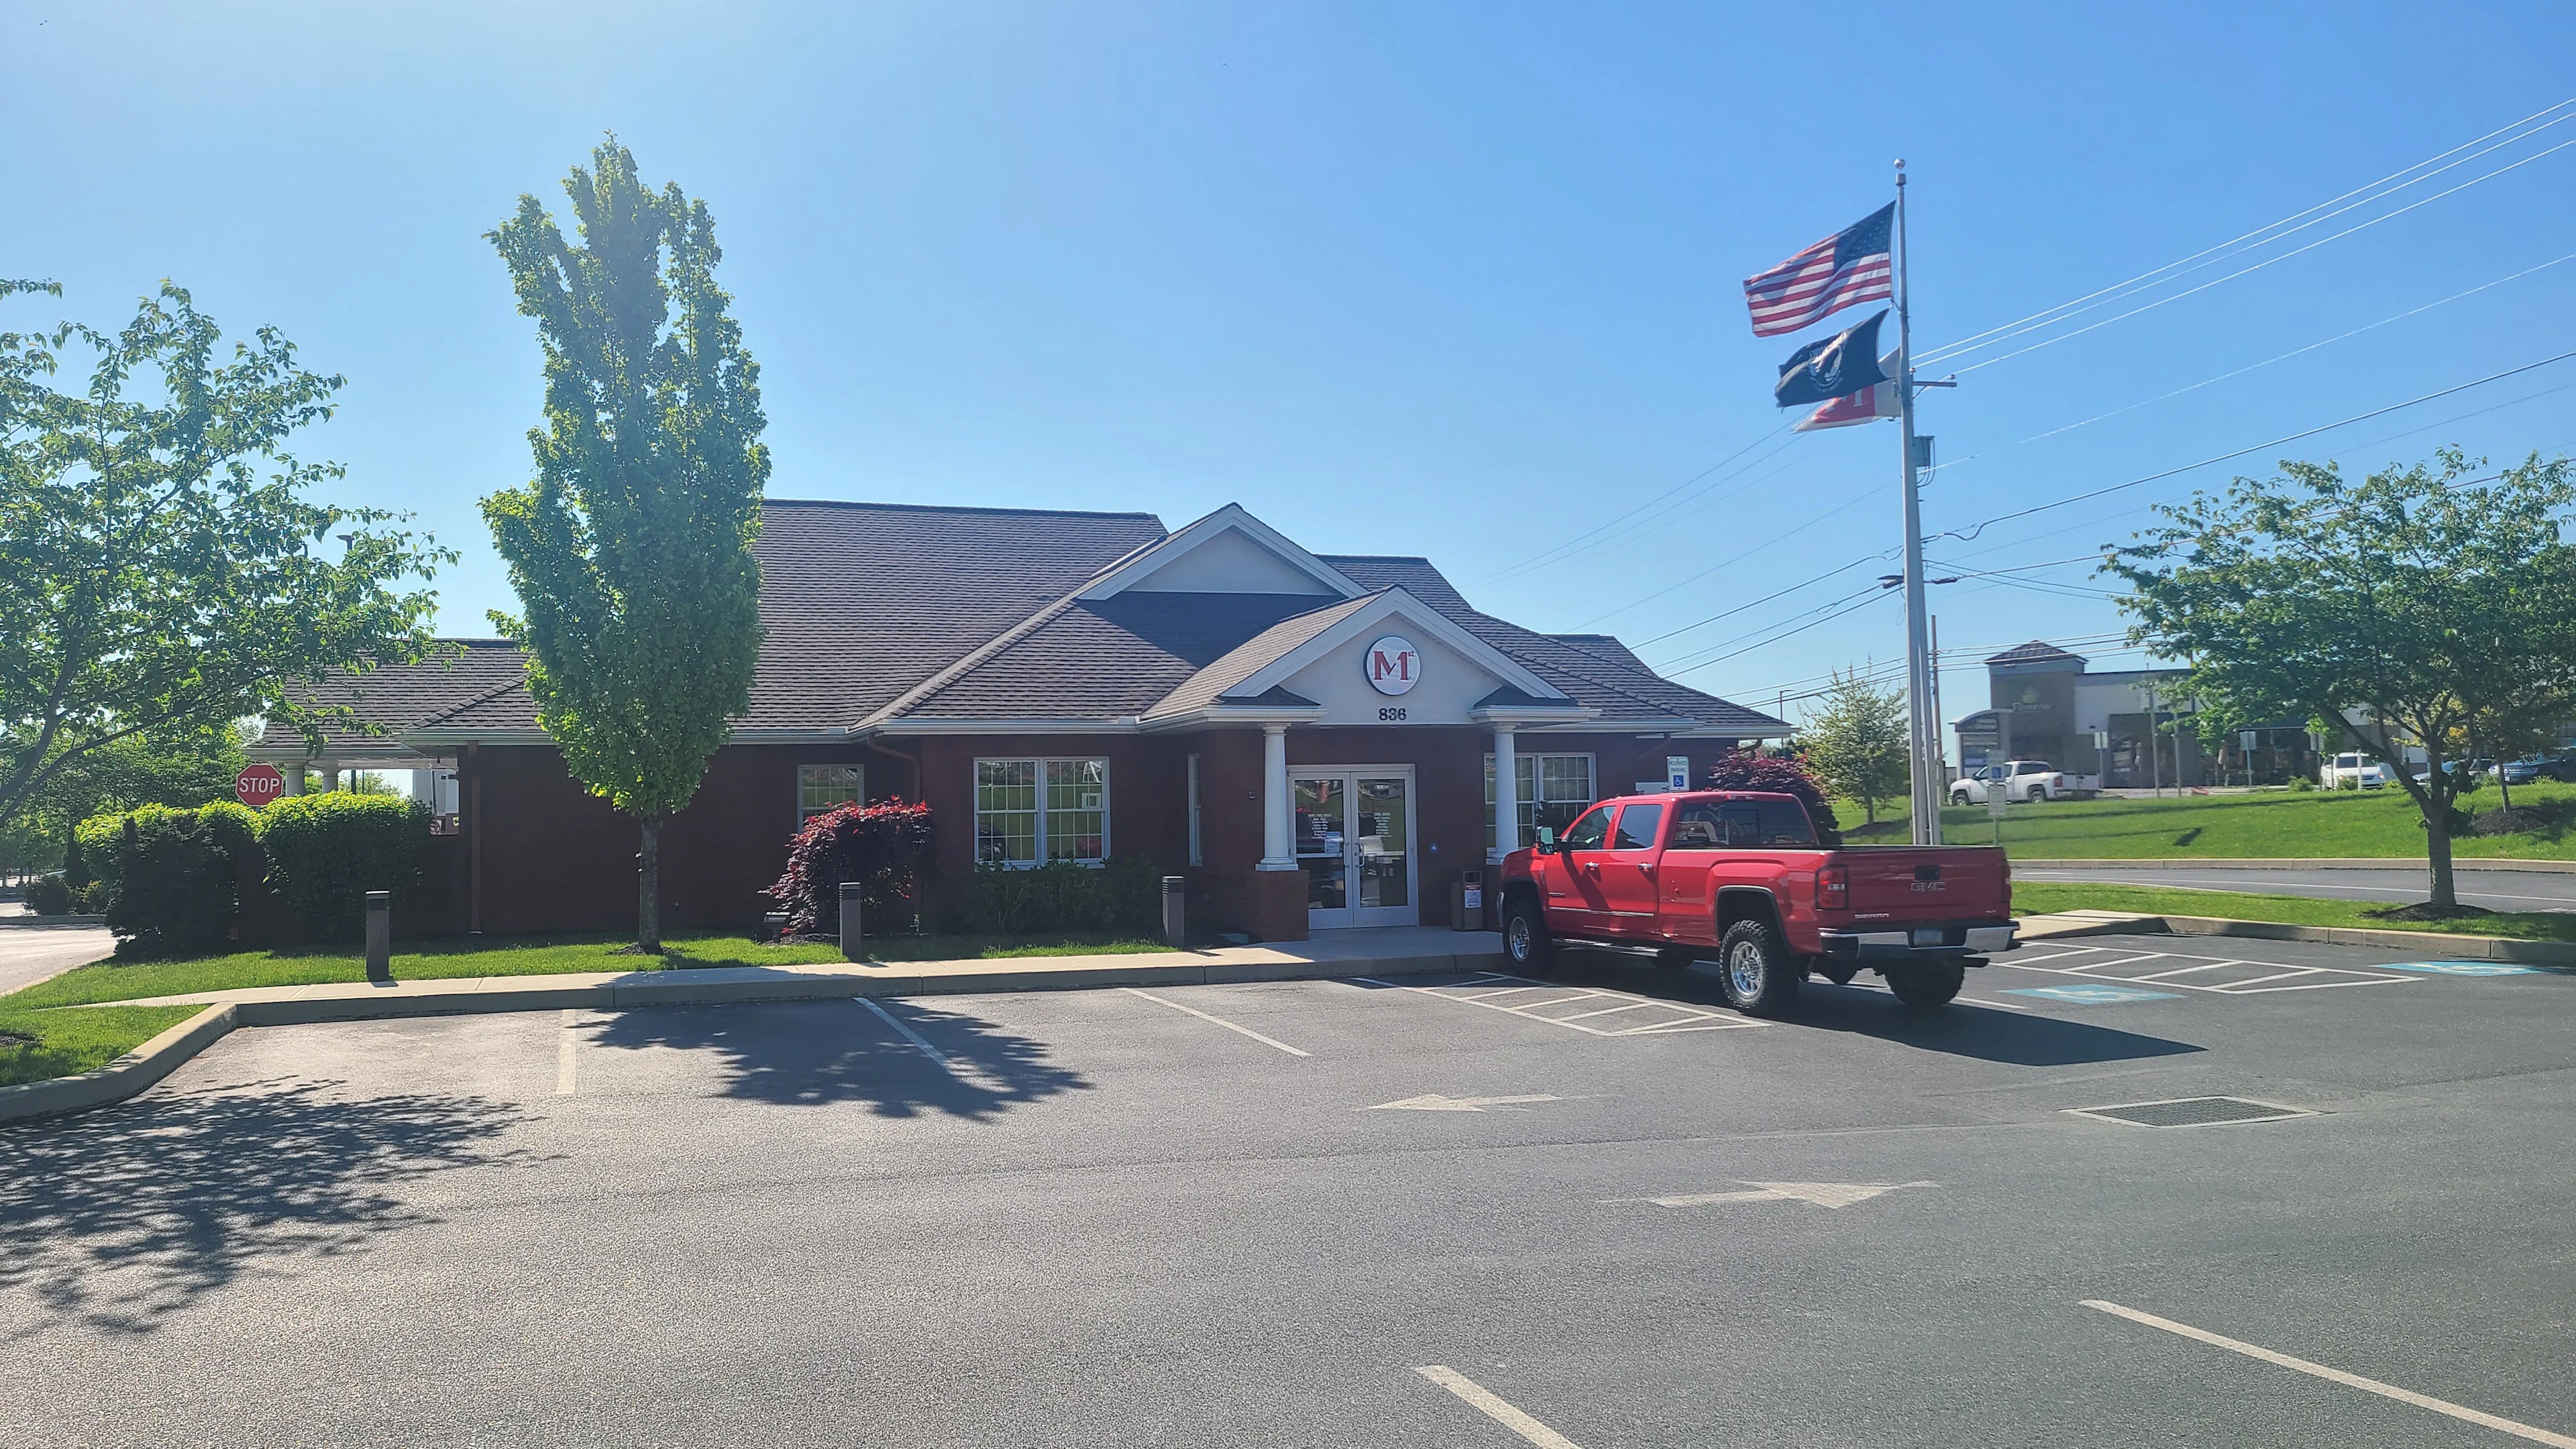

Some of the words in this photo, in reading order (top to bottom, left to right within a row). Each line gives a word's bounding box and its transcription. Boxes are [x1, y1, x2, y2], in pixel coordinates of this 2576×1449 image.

[1379, 708, 1407, 721] 836
[239, 777, 280, 794] STOP
[1911, 882, 1946, 893] GMC
